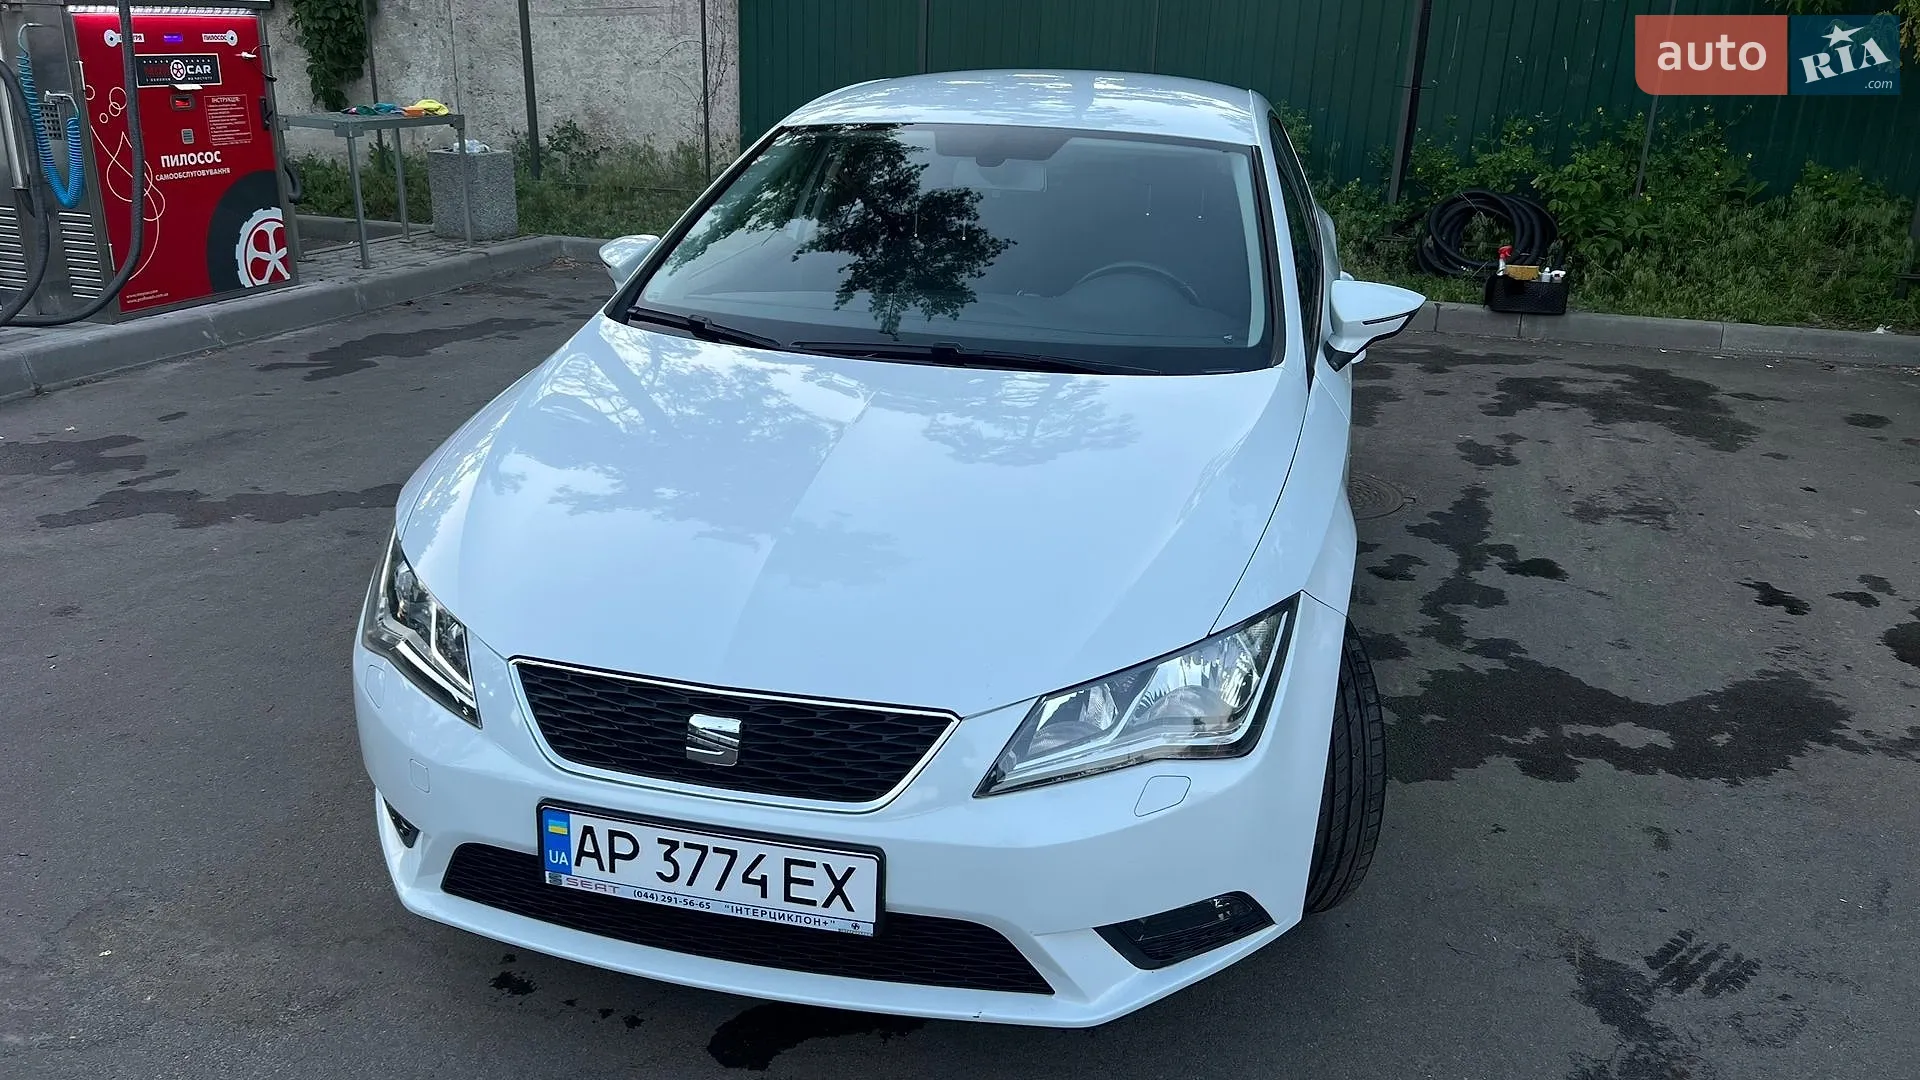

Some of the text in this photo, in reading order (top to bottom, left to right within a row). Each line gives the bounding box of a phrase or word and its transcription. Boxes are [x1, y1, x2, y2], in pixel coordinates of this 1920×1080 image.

[186, 65, 212, 75] CAR
[160, 150, 222, 168] ПИЛОСОС
[549, 849, 569, 866] UA
[574, 824, 857, 913] AP 3774 EX
[566, 877, 620, 894] SEAT
[633, 888, 659, 902] (044)
[661, 894, 711, 910] 291-56-65
